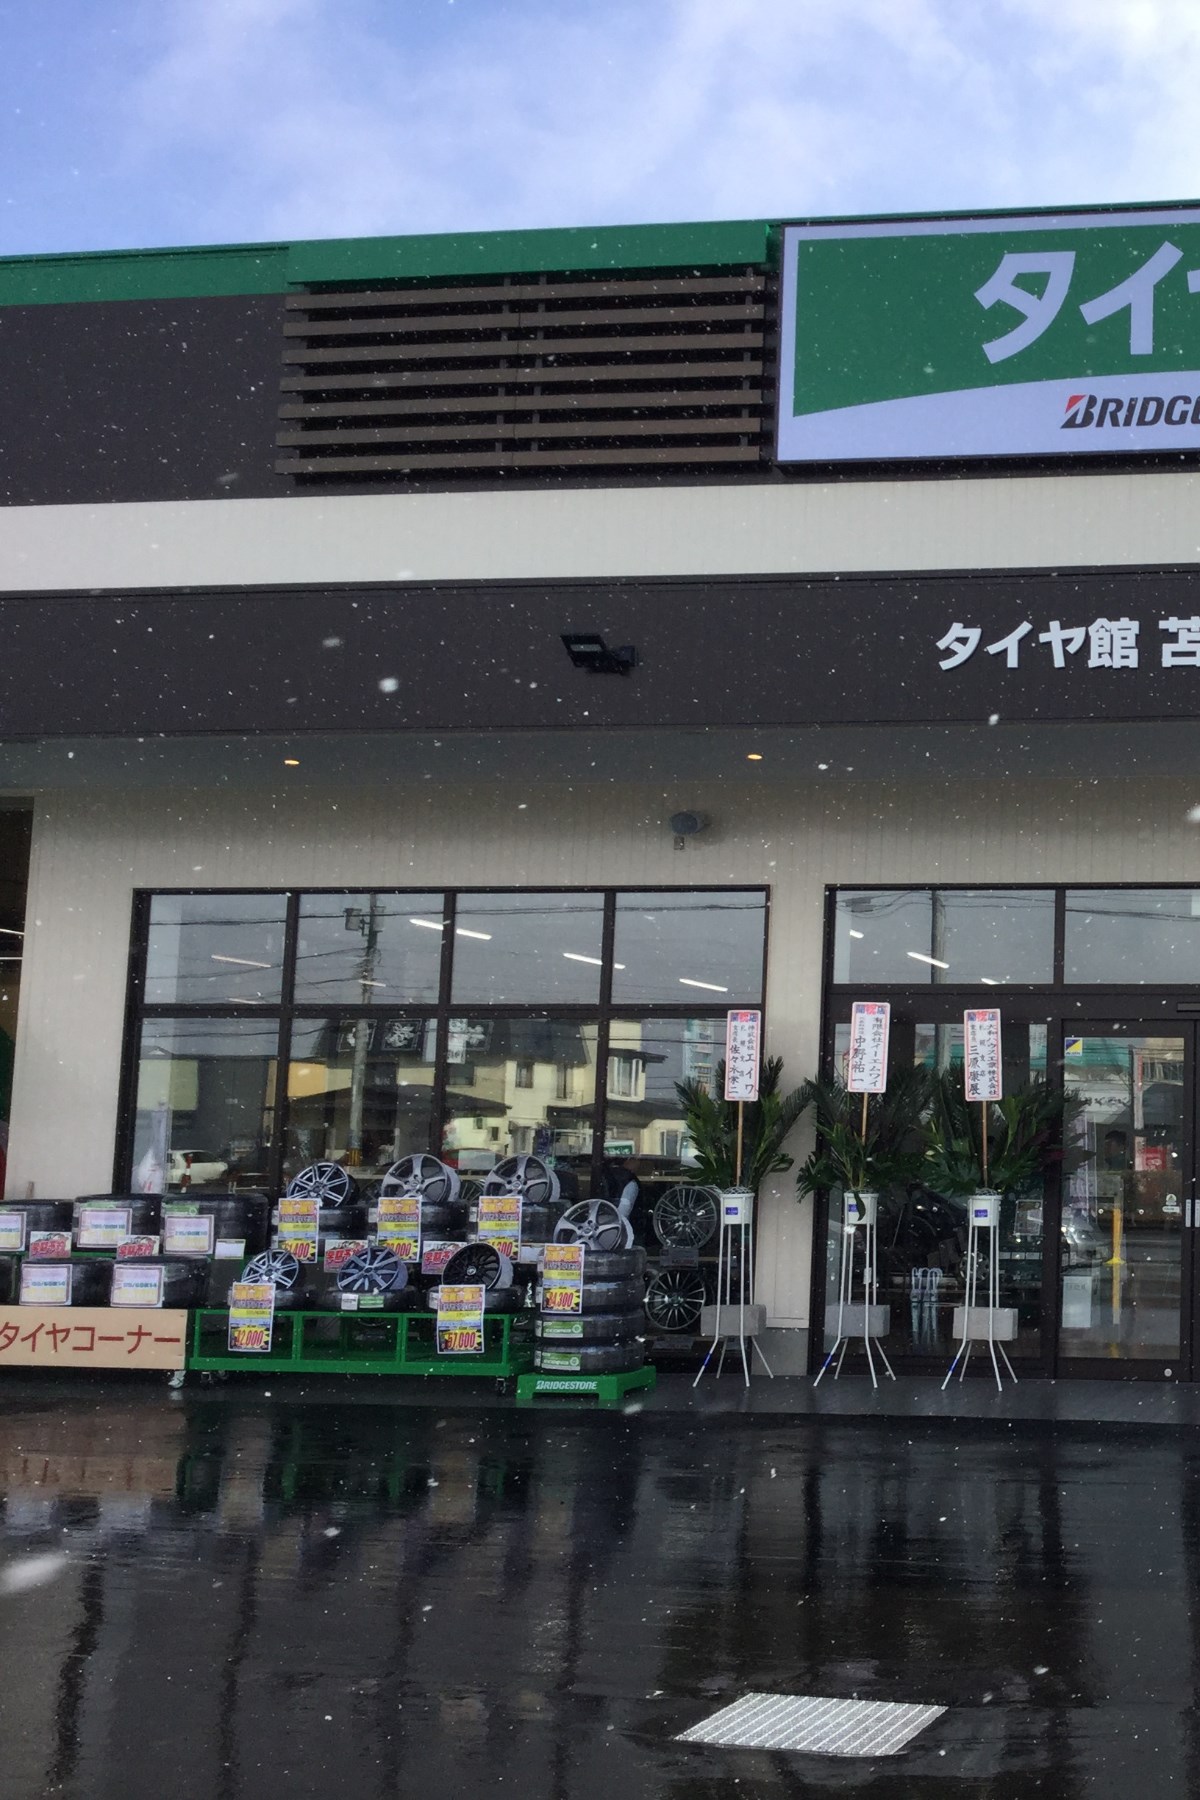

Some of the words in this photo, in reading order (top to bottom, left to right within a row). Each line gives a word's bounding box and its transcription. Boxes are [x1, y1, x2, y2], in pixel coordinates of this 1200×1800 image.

[935, 617, 1140, 671] タイヤ館
[0, 1322, 181, 1354] タイヤコーナー
[536, 1380, 598, 1390] BRIDGESTONE
